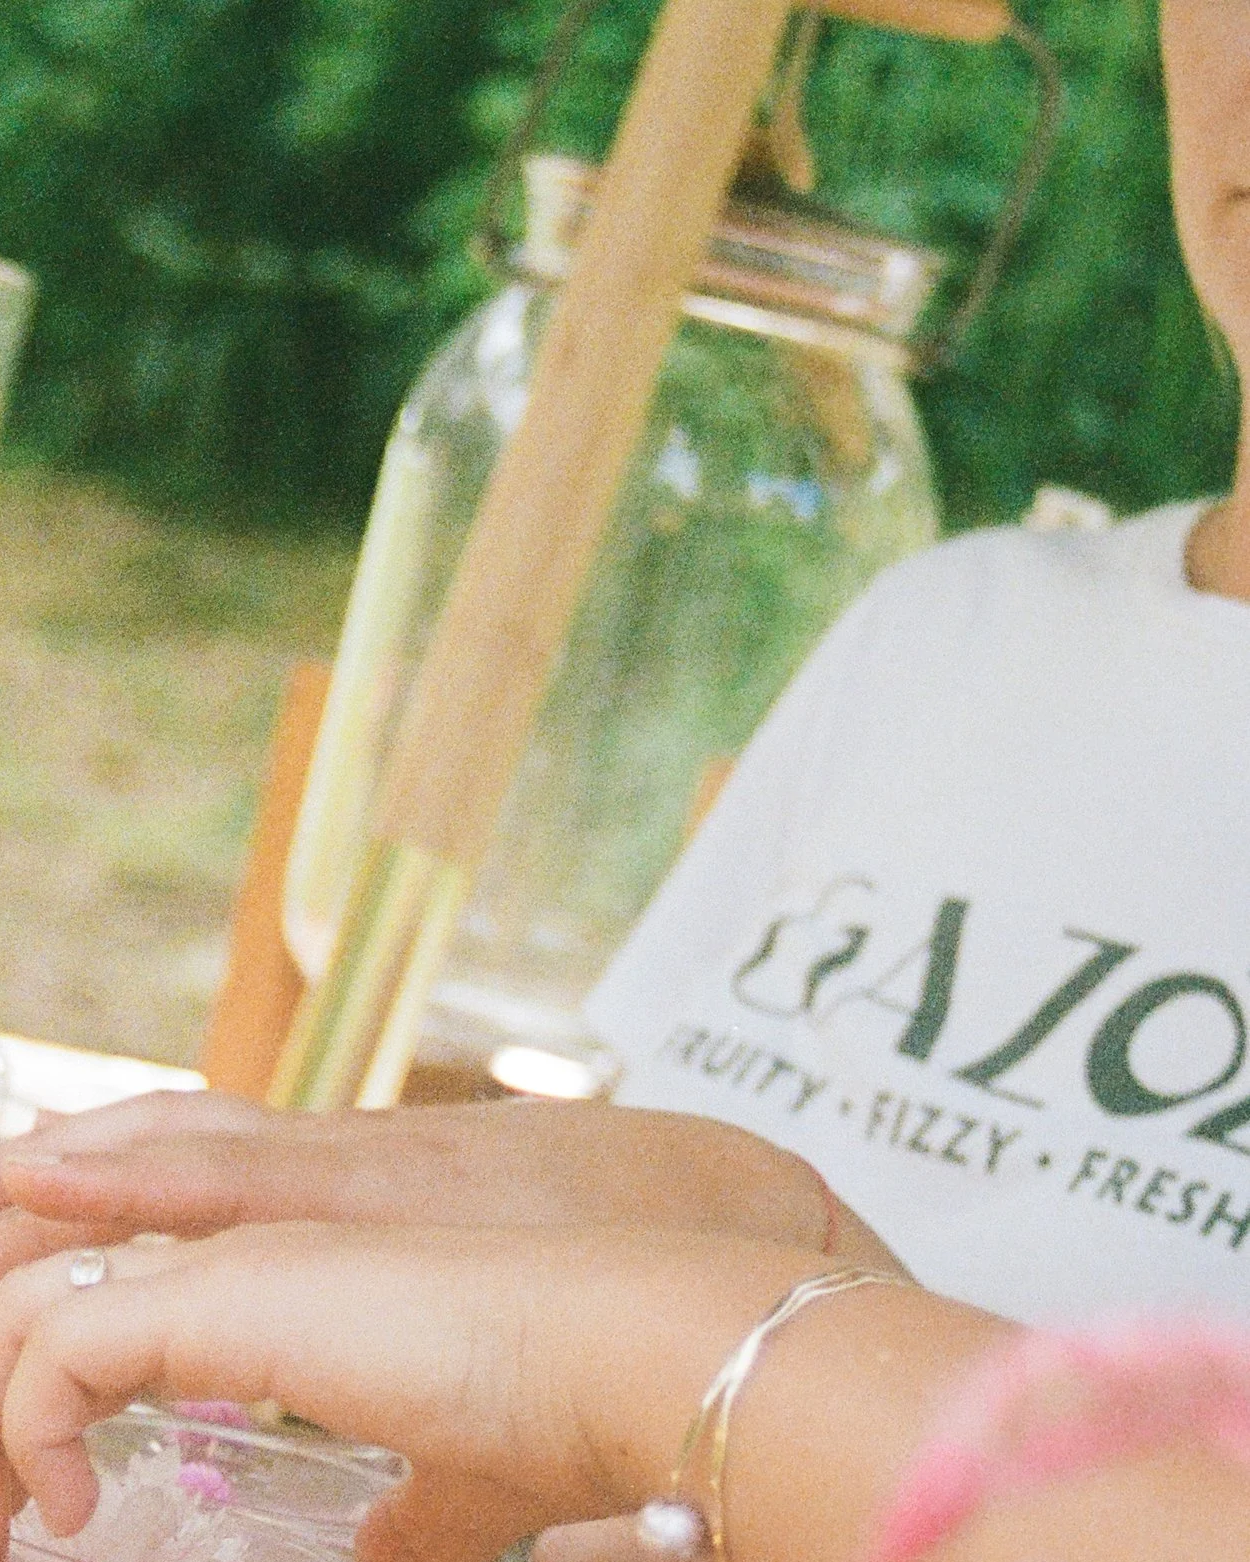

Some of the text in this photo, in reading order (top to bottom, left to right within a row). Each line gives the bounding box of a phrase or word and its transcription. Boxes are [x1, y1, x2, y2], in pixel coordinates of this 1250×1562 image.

[731, 871, 1250, 1157] GAZO
[865, 1090, 1020, 1176] FIZZY
[1067, 1147, 1250, 1250] FRESH
